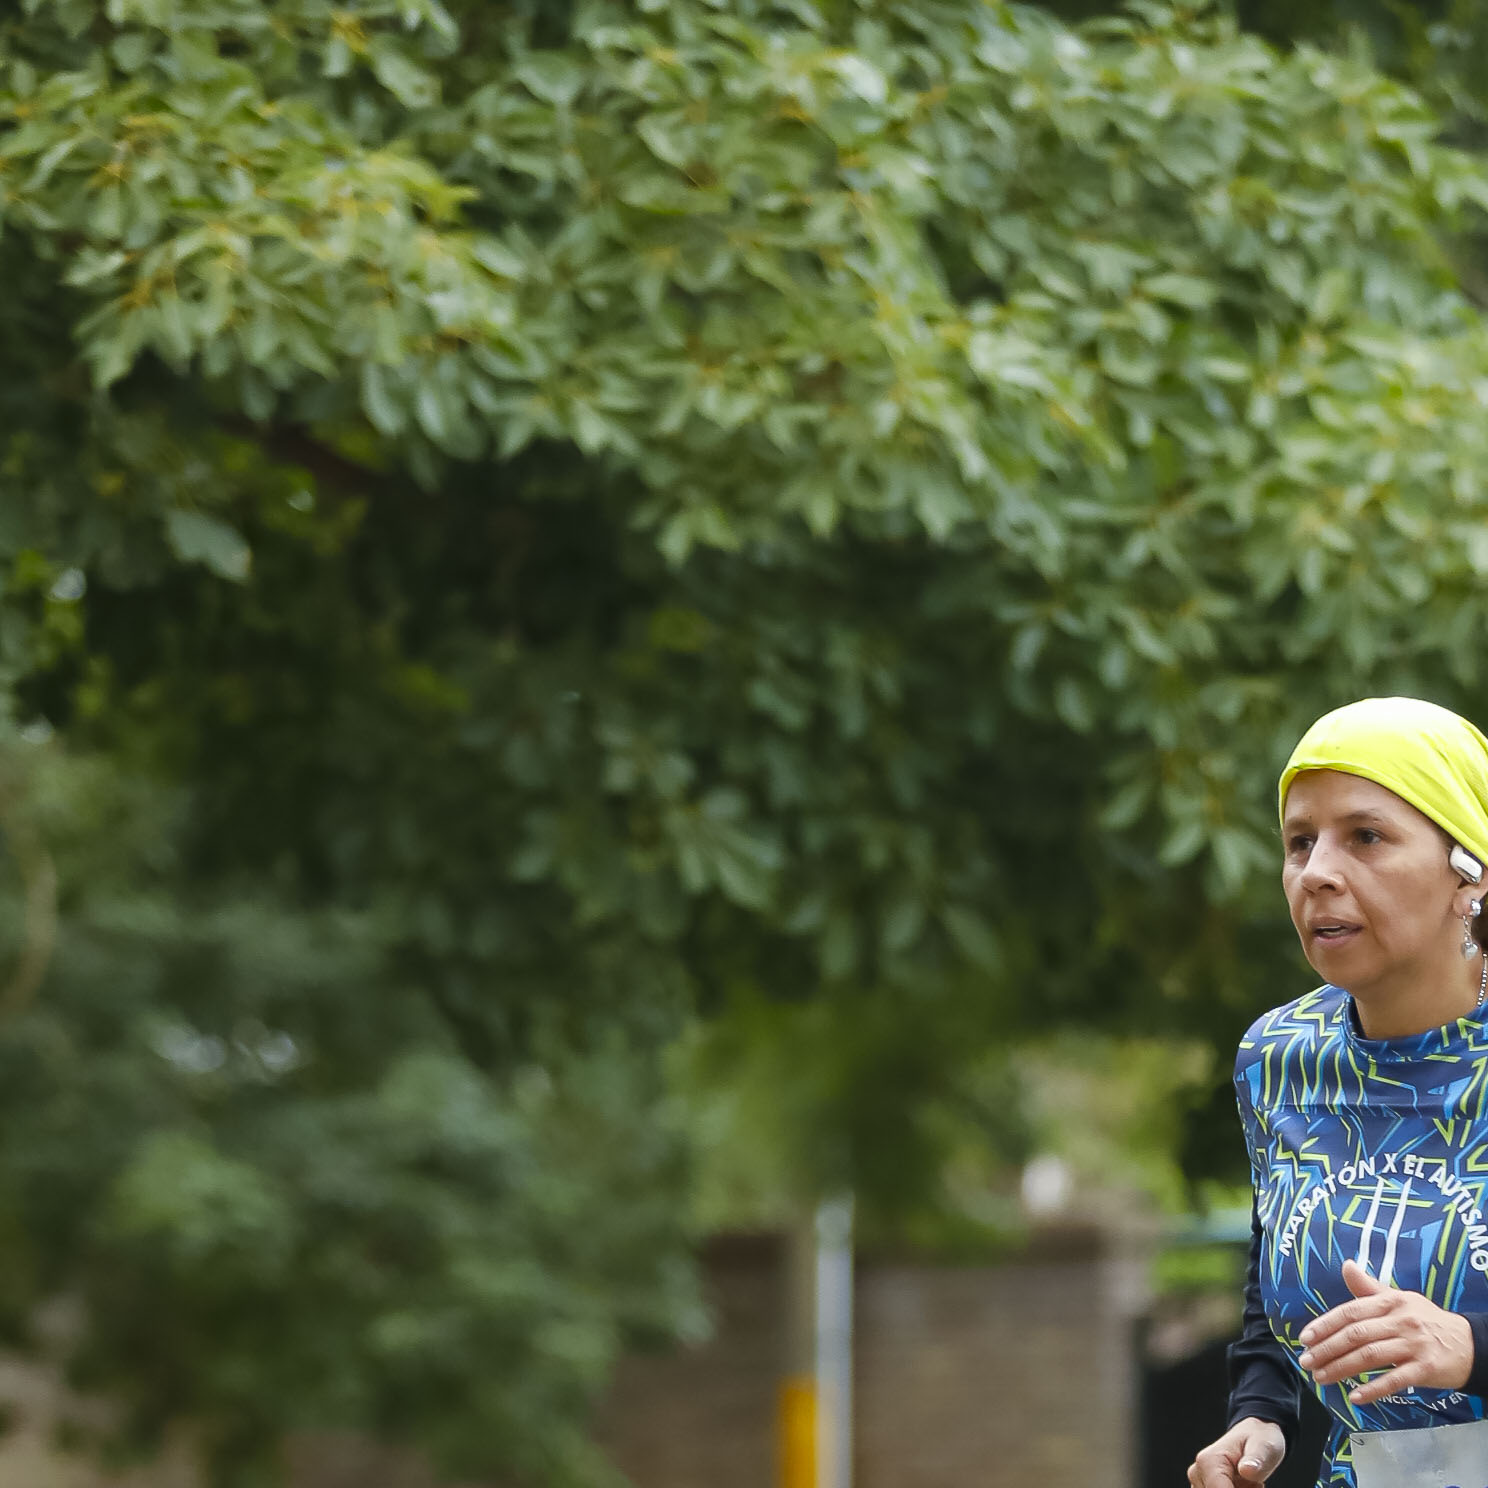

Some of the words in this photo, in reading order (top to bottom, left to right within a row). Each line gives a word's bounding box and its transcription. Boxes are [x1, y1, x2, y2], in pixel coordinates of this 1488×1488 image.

[1278, 1155, 1375, 1257] MARATÓN
[1383, 1152, 1398, 1174] X
[1403, 1153, 1425, 1179] EL
